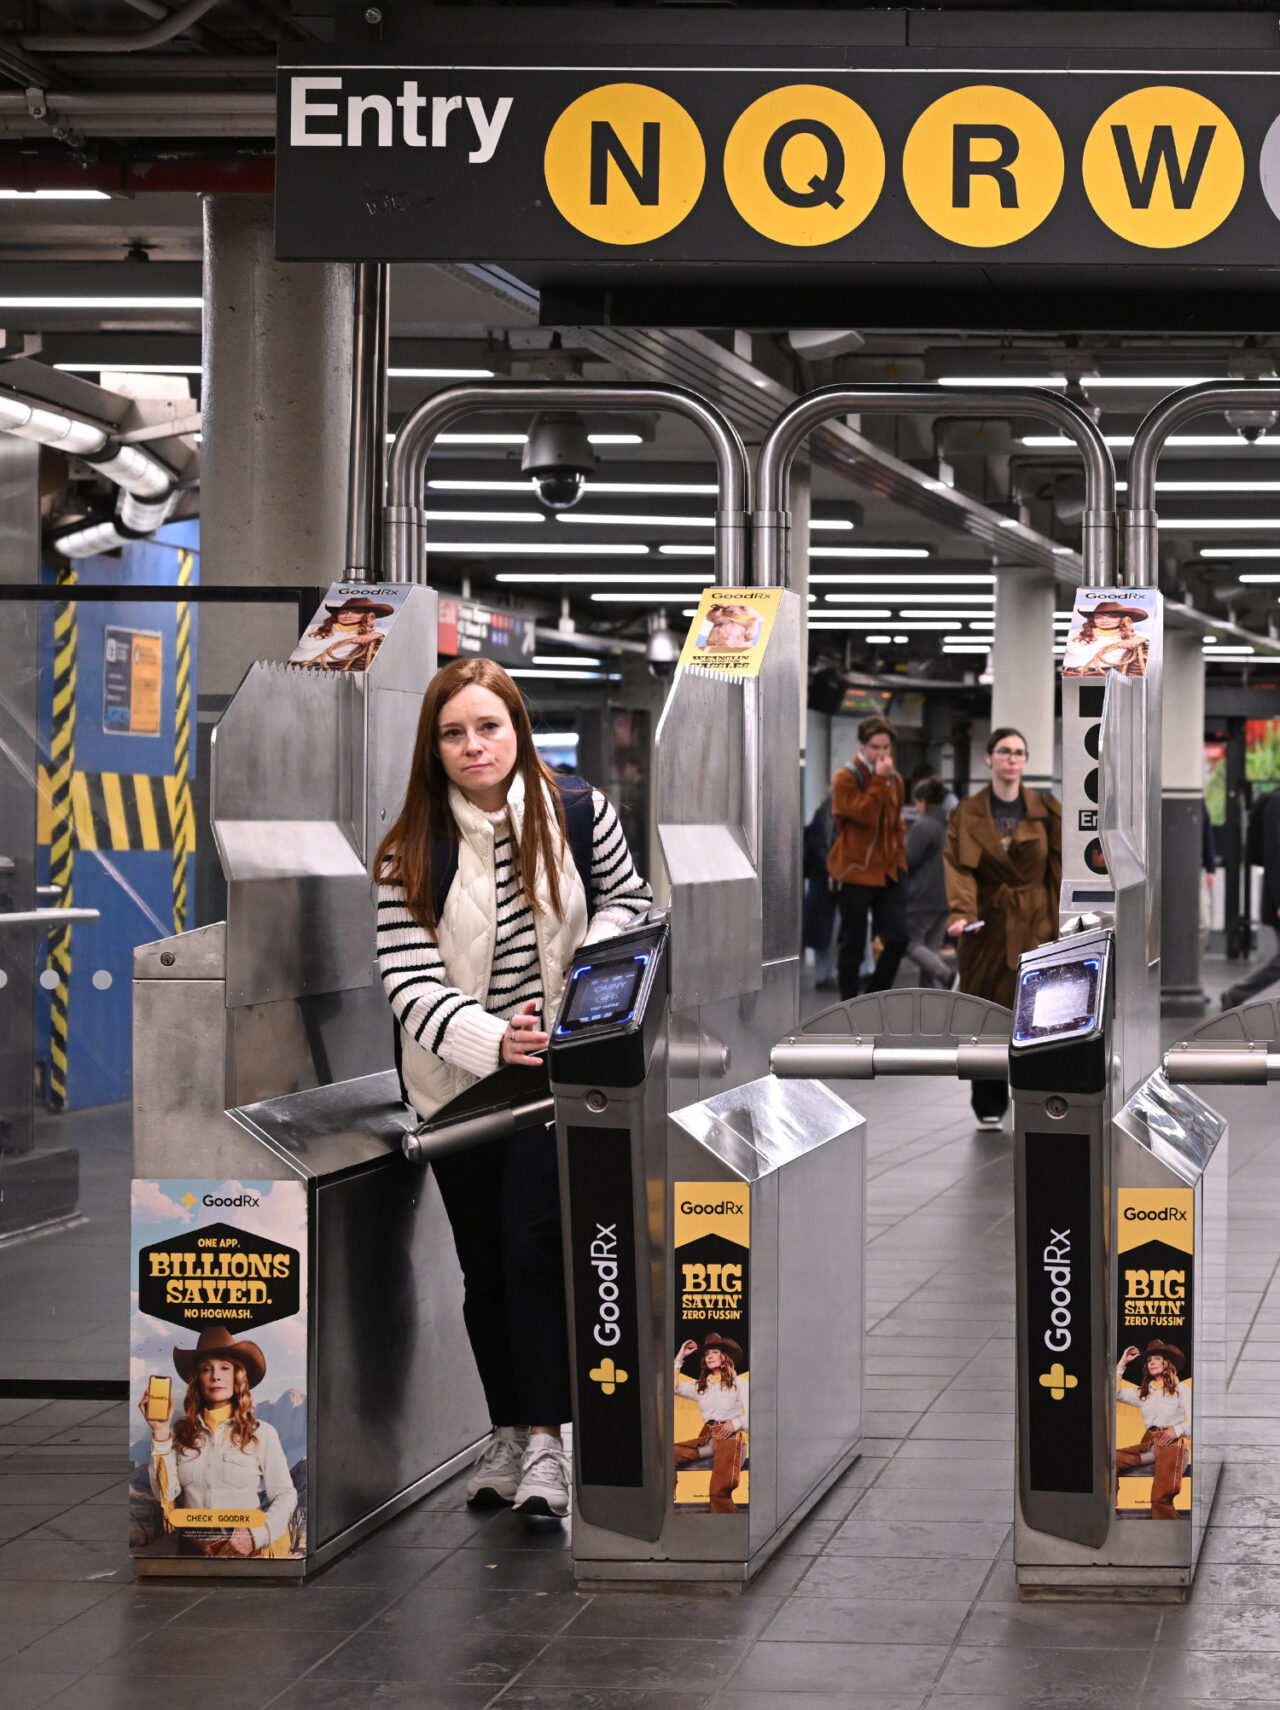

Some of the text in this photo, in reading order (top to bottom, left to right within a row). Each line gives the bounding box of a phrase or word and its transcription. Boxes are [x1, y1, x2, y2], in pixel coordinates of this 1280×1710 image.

[289, 76, 514, 164] Entry
[589, 120, 660, 206] N
[763, 118, 846, 210] Q
[951, 123, 1020, 209] R
[1110, 124, 1218, 210] W
[338, 588, 398, 596] GoodRx
[1085, 592, 1146, 600] GoodRx
[202, 1194, 260, 1207] GoodRx
[680, 1201, 744, 1215] GoodRx
[1123, 1206, 1187, 1221] GoodRx
[197, 1238, 241, 1248] ONE APP.
[149, 1252, 290, 1278] BILLIONS
[591, 1222, 621, 1347] GoodRx
[682, 1263, 742, 1292] BIG
[1124, 1269, 1185, 1299] BIG
[165, 1279, 273, 1305] SAVED.
[1043, 1228, 1072, 1353] GoodRx
[682, 1294, 742, 1308] SAVIN'
[1124, 1300, 1185, 1315] SAVIN'
[184, 1309, 253, 1319] NO HOGWASH.
[682, 1310, 743, 1320] ZERO FUSSIN'
[1124, 1316, 1185, 1326] ZERO FUSSIN'
[218, 1515, 250, 1523] GOODRX
